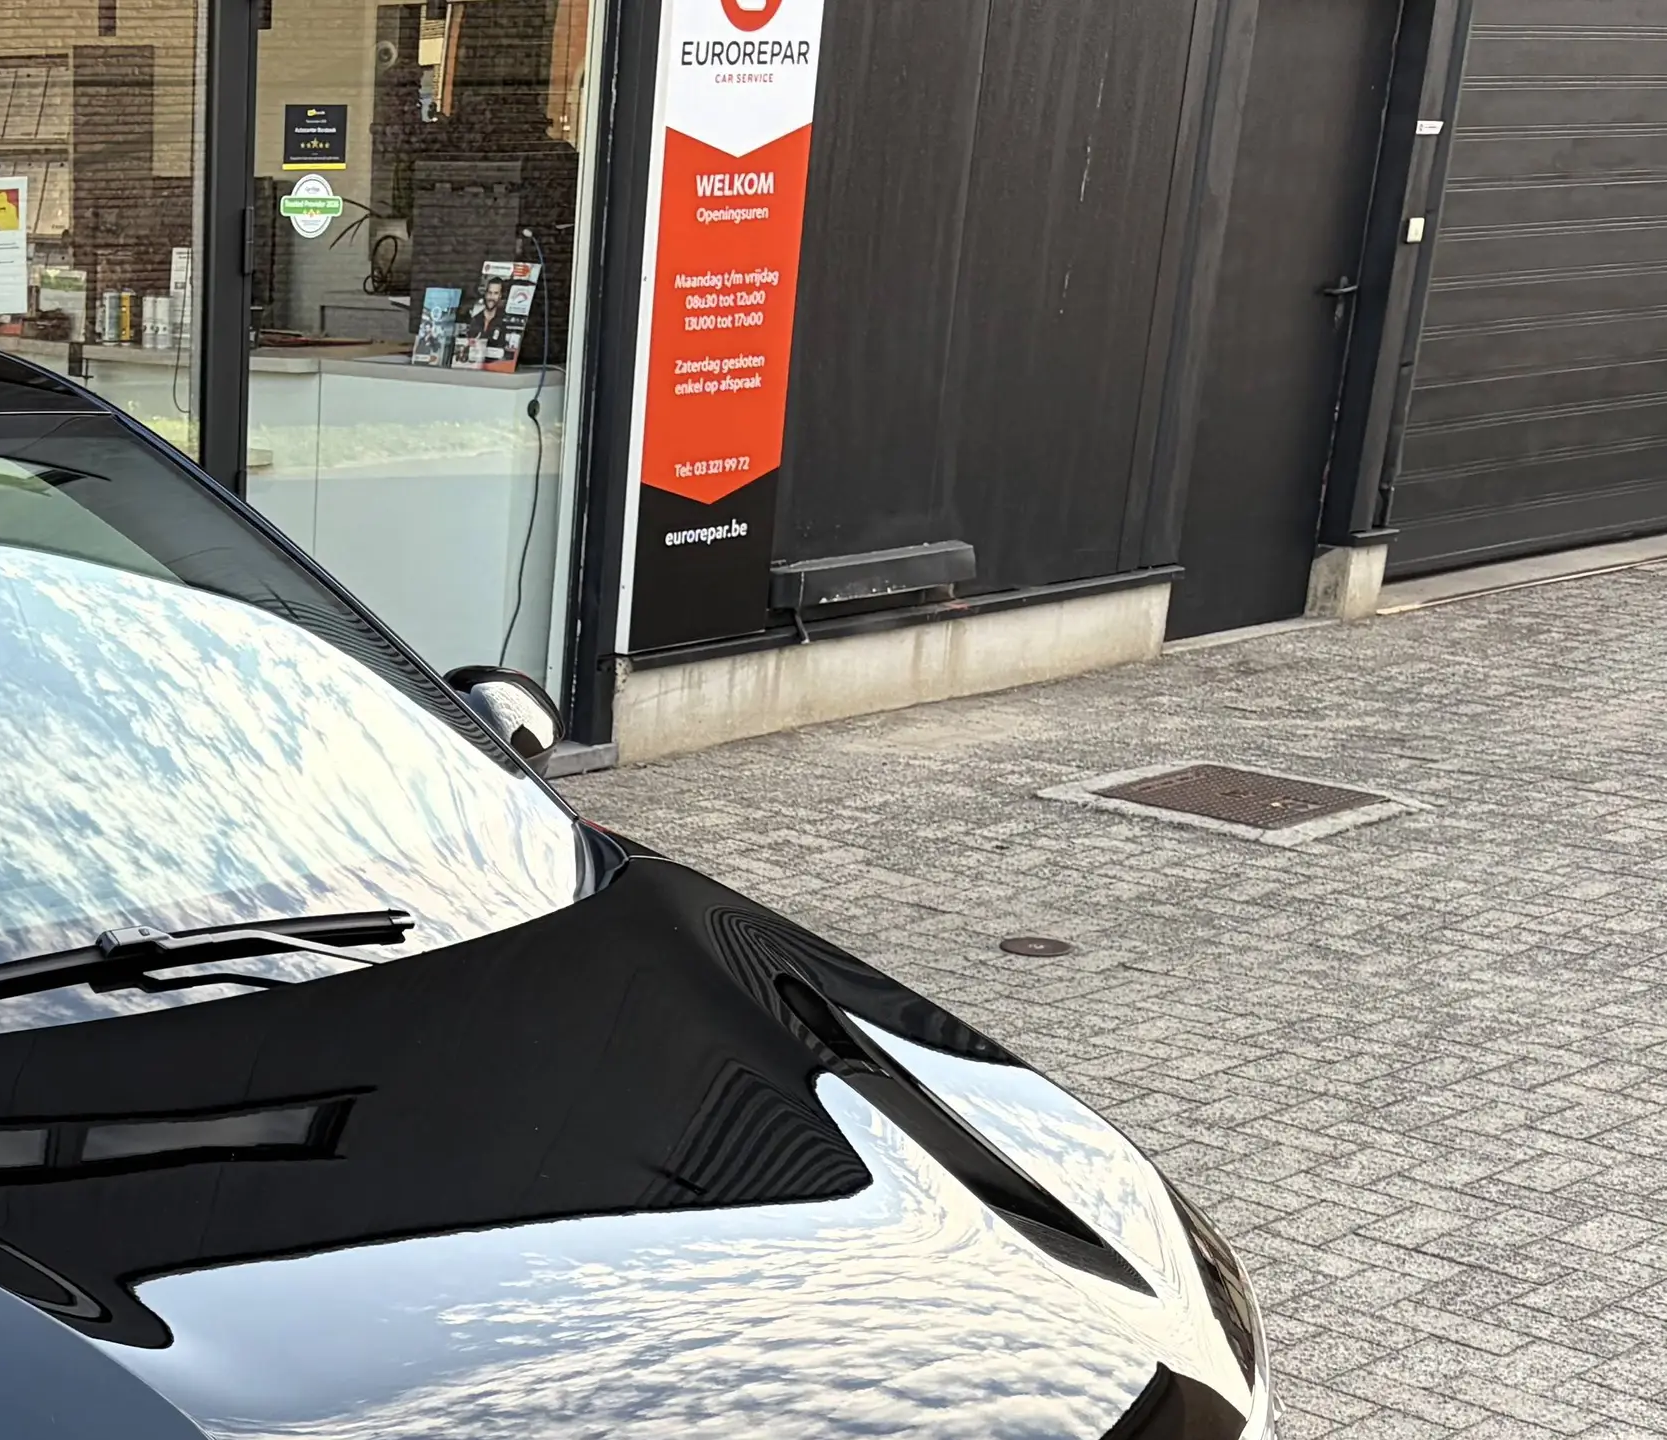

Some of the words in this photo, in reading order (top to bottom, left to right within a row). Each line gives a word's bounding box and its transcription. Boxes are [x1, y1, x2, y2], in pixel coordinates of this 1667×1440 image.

[681, 40, 810, 66] EUROREPAR
[714, 74, 733, 84] CAR
[736, 73, 774, 84] SERVICE
[695, 172, 774, 197] WELKOM
[696, 206, 769, 224] Openingsuren
[674, 271, 723, 289] Maandag
[724, 269, 744, 288] t/m
[745, 267, 780, 286] vrijdag
[685, 293, 718, 310] 08u30
[718, 292, 735, 307] tot
[736, 290, 766, 306] 12u00
[717, 313, 733, 329] tot
[734, 312, 764, 326] 17u00
[674, 356, 721, 375] Zaterdag
[721, 353, 765, 374] gesloten
[674, 378, 703, 395] enkel
[704, 380, 719, 395] op
[720, 373, 762, 393] afspraak
[674, 462, 692, 478] Tel:
[693, 460, 707, 476] 03
[707, 458, 723, 474] 321
[724, 457, 737, 472] 99
[738, 456, 750, 470] 72
[664, 518, 748, 546] eurorepar.be
